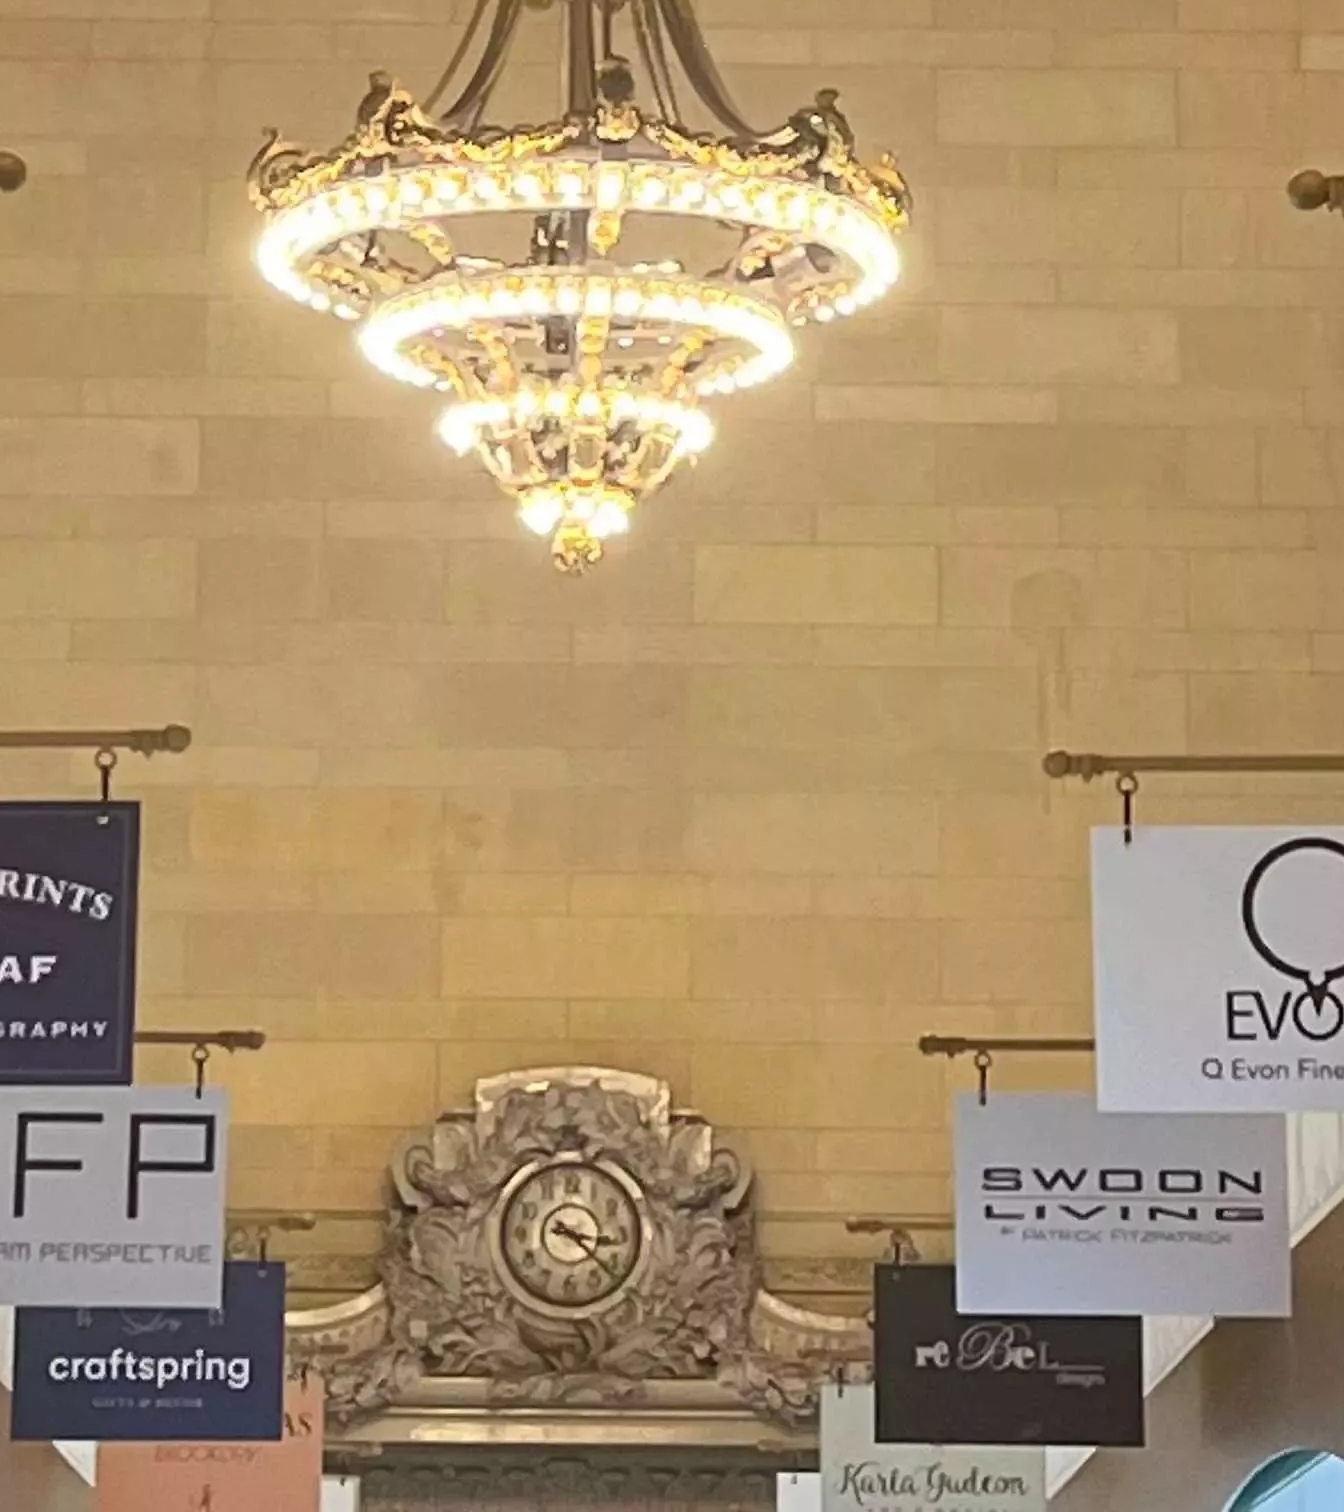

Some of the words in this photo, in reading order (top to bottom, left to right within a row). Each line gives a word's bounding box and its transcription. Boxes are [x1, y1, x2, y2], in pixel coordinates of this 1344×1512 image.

[1201, 1057, 1224, 1080] Q
[1230, 1057, 1290, 1081] Evon
[981, 1167, 1263, 1194] SWOON
[984, 1203, 1265, 1222] LIVING
[39, 1241, 213, 1264] PERSPECTIVE
[47, 1347, 252, 1389] craftspring
[835, 1460, 918, 1507] Karla
